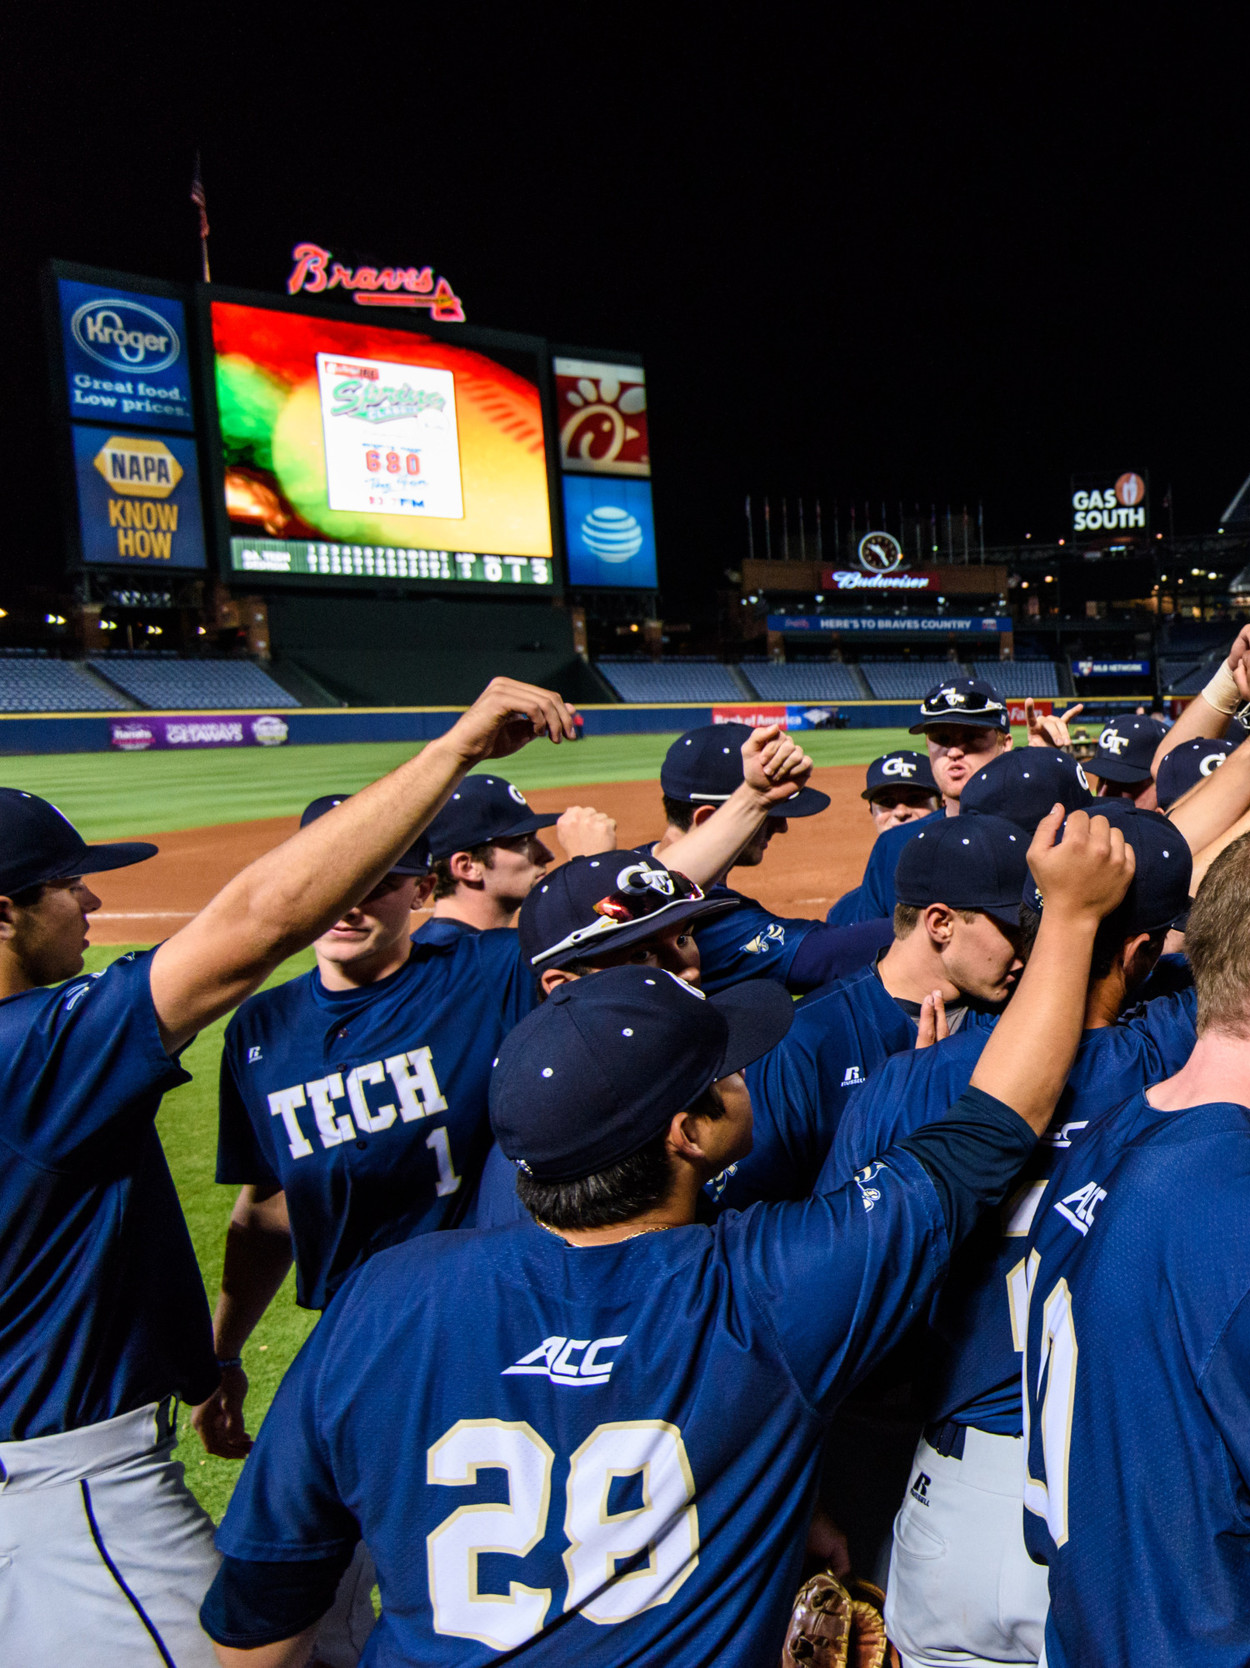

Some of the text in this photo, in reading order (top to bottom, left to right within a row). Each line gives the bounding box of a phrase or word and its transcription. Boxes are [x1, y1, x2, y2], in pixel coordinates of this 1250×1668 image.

[288, 243, 434, 294] Braves
[86, 311, 169, 363] Kroger
[74, 374, 187, 401] Great food.
[74, 390, 190, 417] Low prices.
[111, 452, 171, 484] NAPA
[1072, 488, 1118, 511] GAS
[109, 499, 178, 531] KNOW
[1073, 506, 1146, 532] SOUTH
[117, 529, 172, 559] HOW
[532, 565, 549, 583] 3
[832, 571, 930, 589] Budweiser
[820, 618, 860, 629] HERE'S
[861, 618, 876, 629] TO
[877, 618, 920, 629] BRAVES
[921, 618, 972, 630] COUNTRY
[744, 714, 756, 726] of
[757, 714, 802, 726] America
[166, 729, 244, 744] GETAWAYS
[1099, 728, 1129, 755] GT
[881, 757, 917, 777] GT
[267, 1045, 449, 1161] TECH
[425, 1126, 462, 1197] 1
[506, 1335, 628, 1384] ACC
[427, 1418, 700, 1651] 28
